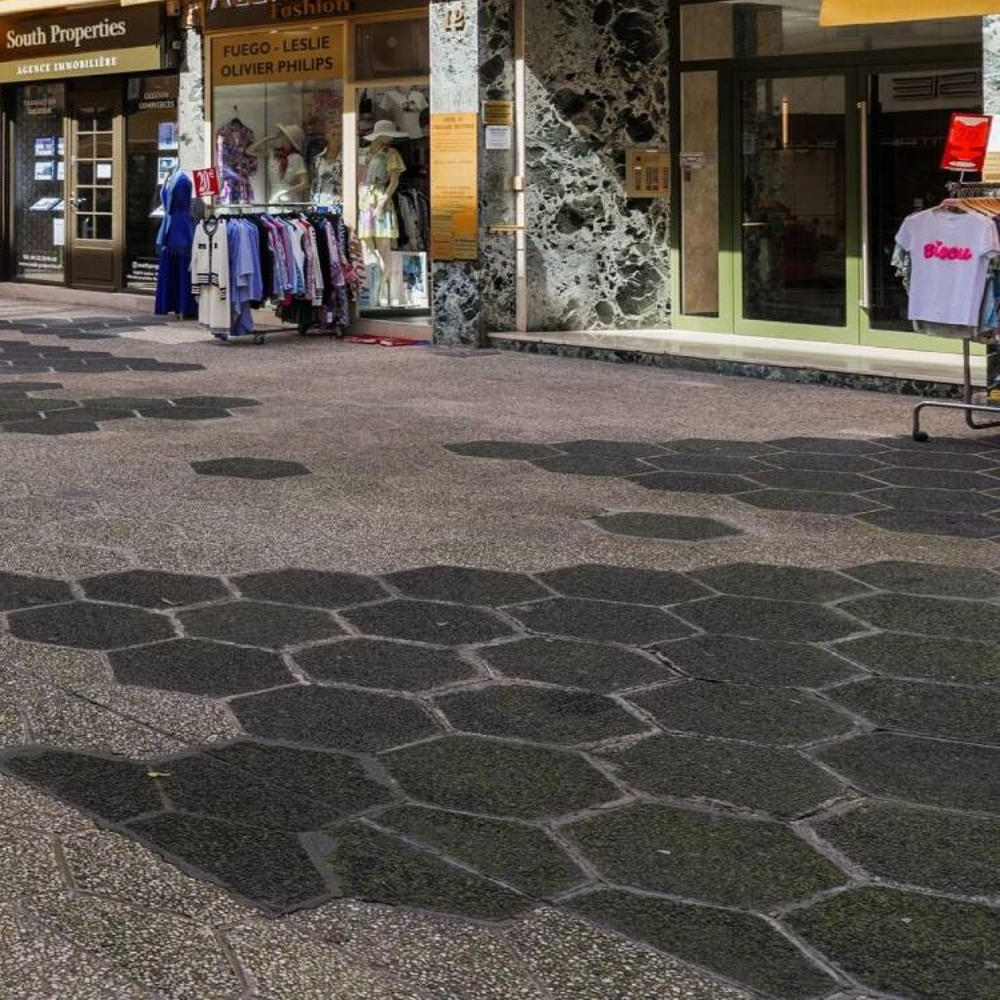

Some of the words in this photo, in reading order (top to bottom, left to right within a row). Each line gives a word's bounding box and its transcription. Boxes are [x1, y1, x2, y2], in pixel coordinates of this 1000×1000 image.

[6, 26, 47, 49] South
[51, 18, 126, 47] Properties
[223, 40, 271, 58] FUEGO
[283, 36, 331, 53] LESLIE
[16, 61, 50, 76] AGENCE
[220, 60, 275, 78] OLIVIER
[278, 56, 334, 74] PHILIPS
